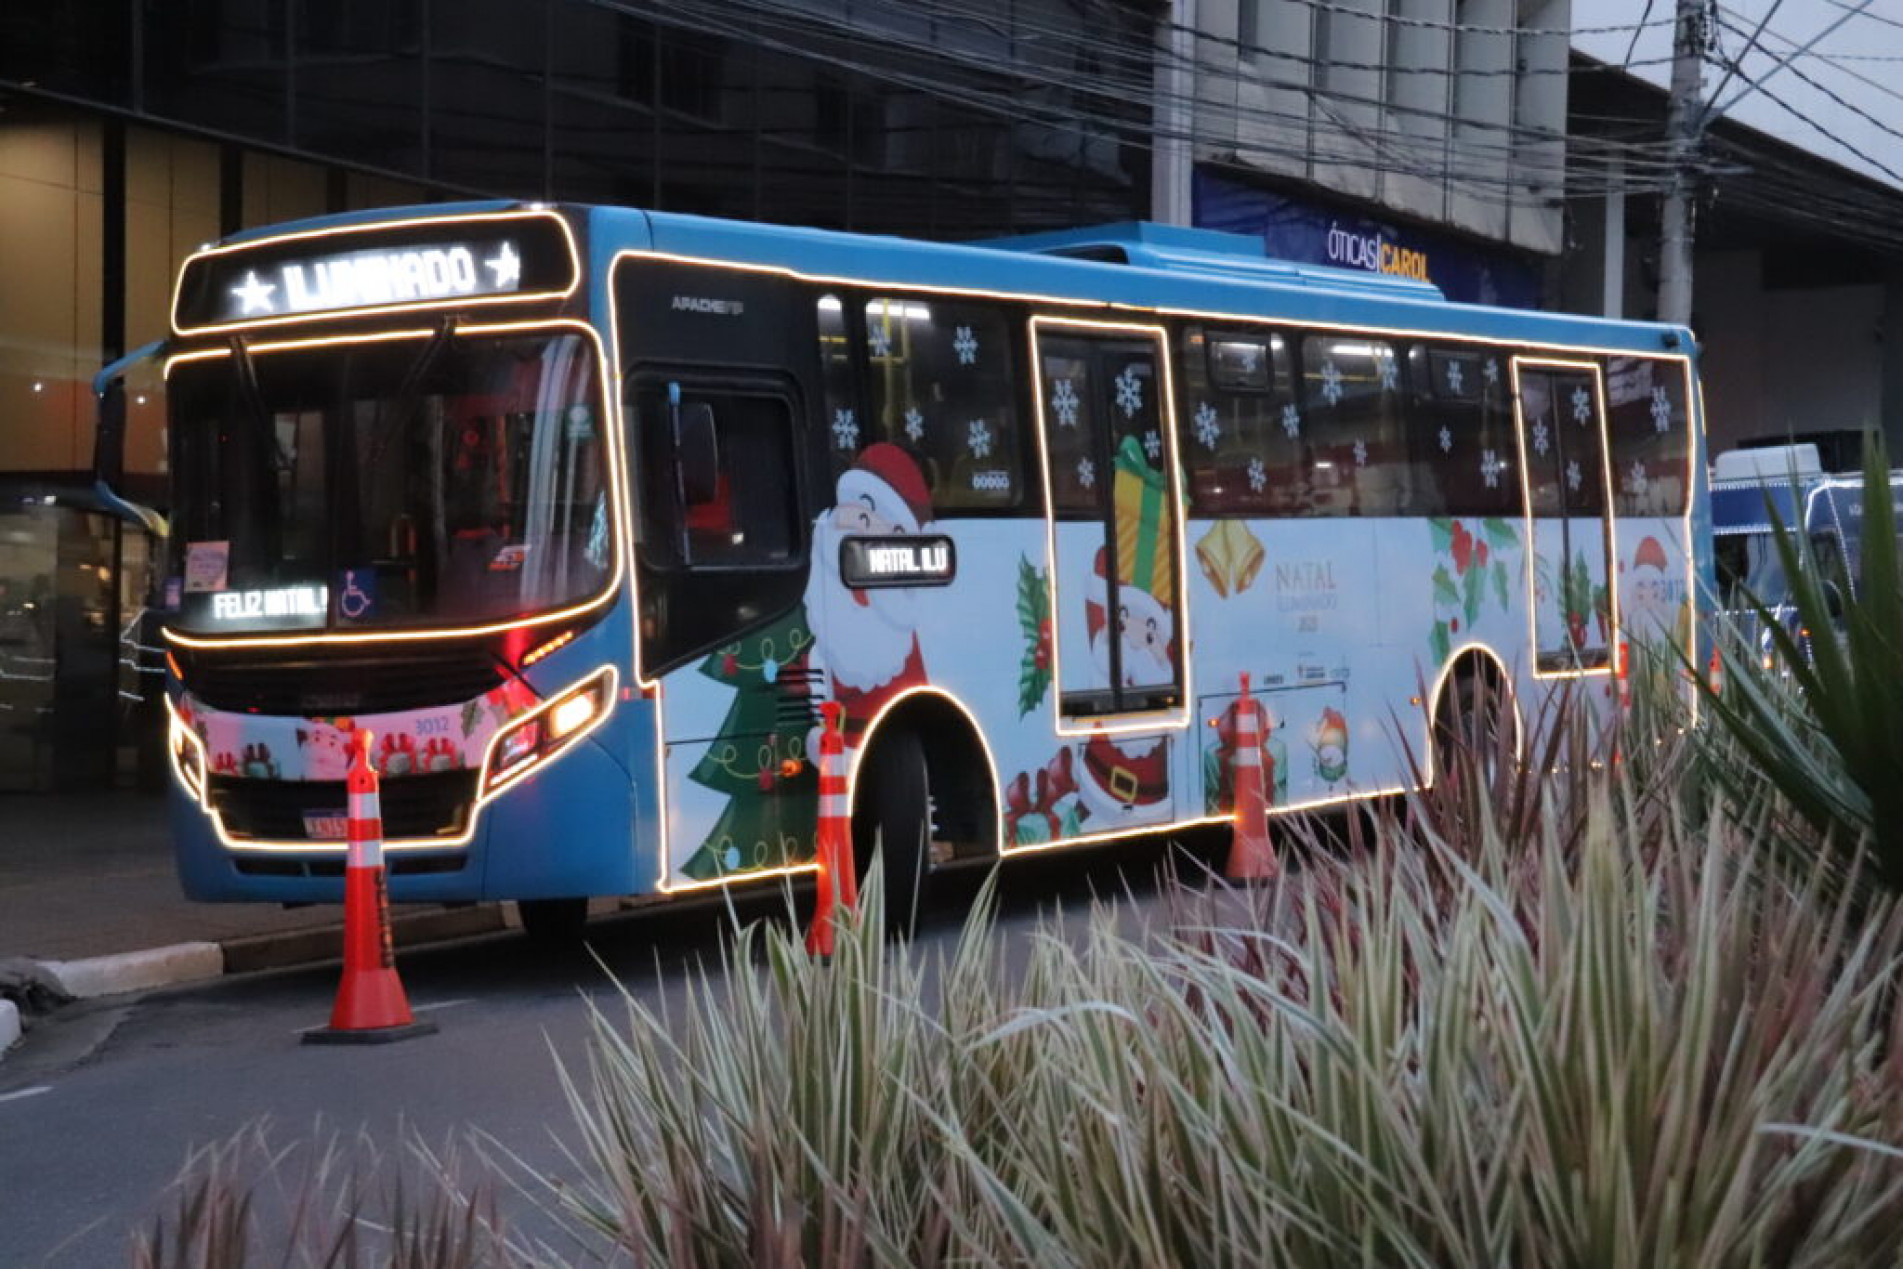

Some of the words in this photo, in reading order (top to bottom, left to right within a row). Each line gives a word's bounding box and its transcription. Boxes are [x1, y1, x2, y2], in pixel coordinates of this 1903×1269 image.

[1328, 220, 1377, 270] ÓTICAS
[1380, 242, 1432, 284] CAROL
[282, 246, 477, 312] ILUMINADO
[869, 549, 921, 573] NATAL
[1275, 559, 1338, 592] NATAL
[213, 590, 263, 620] FELIZ
